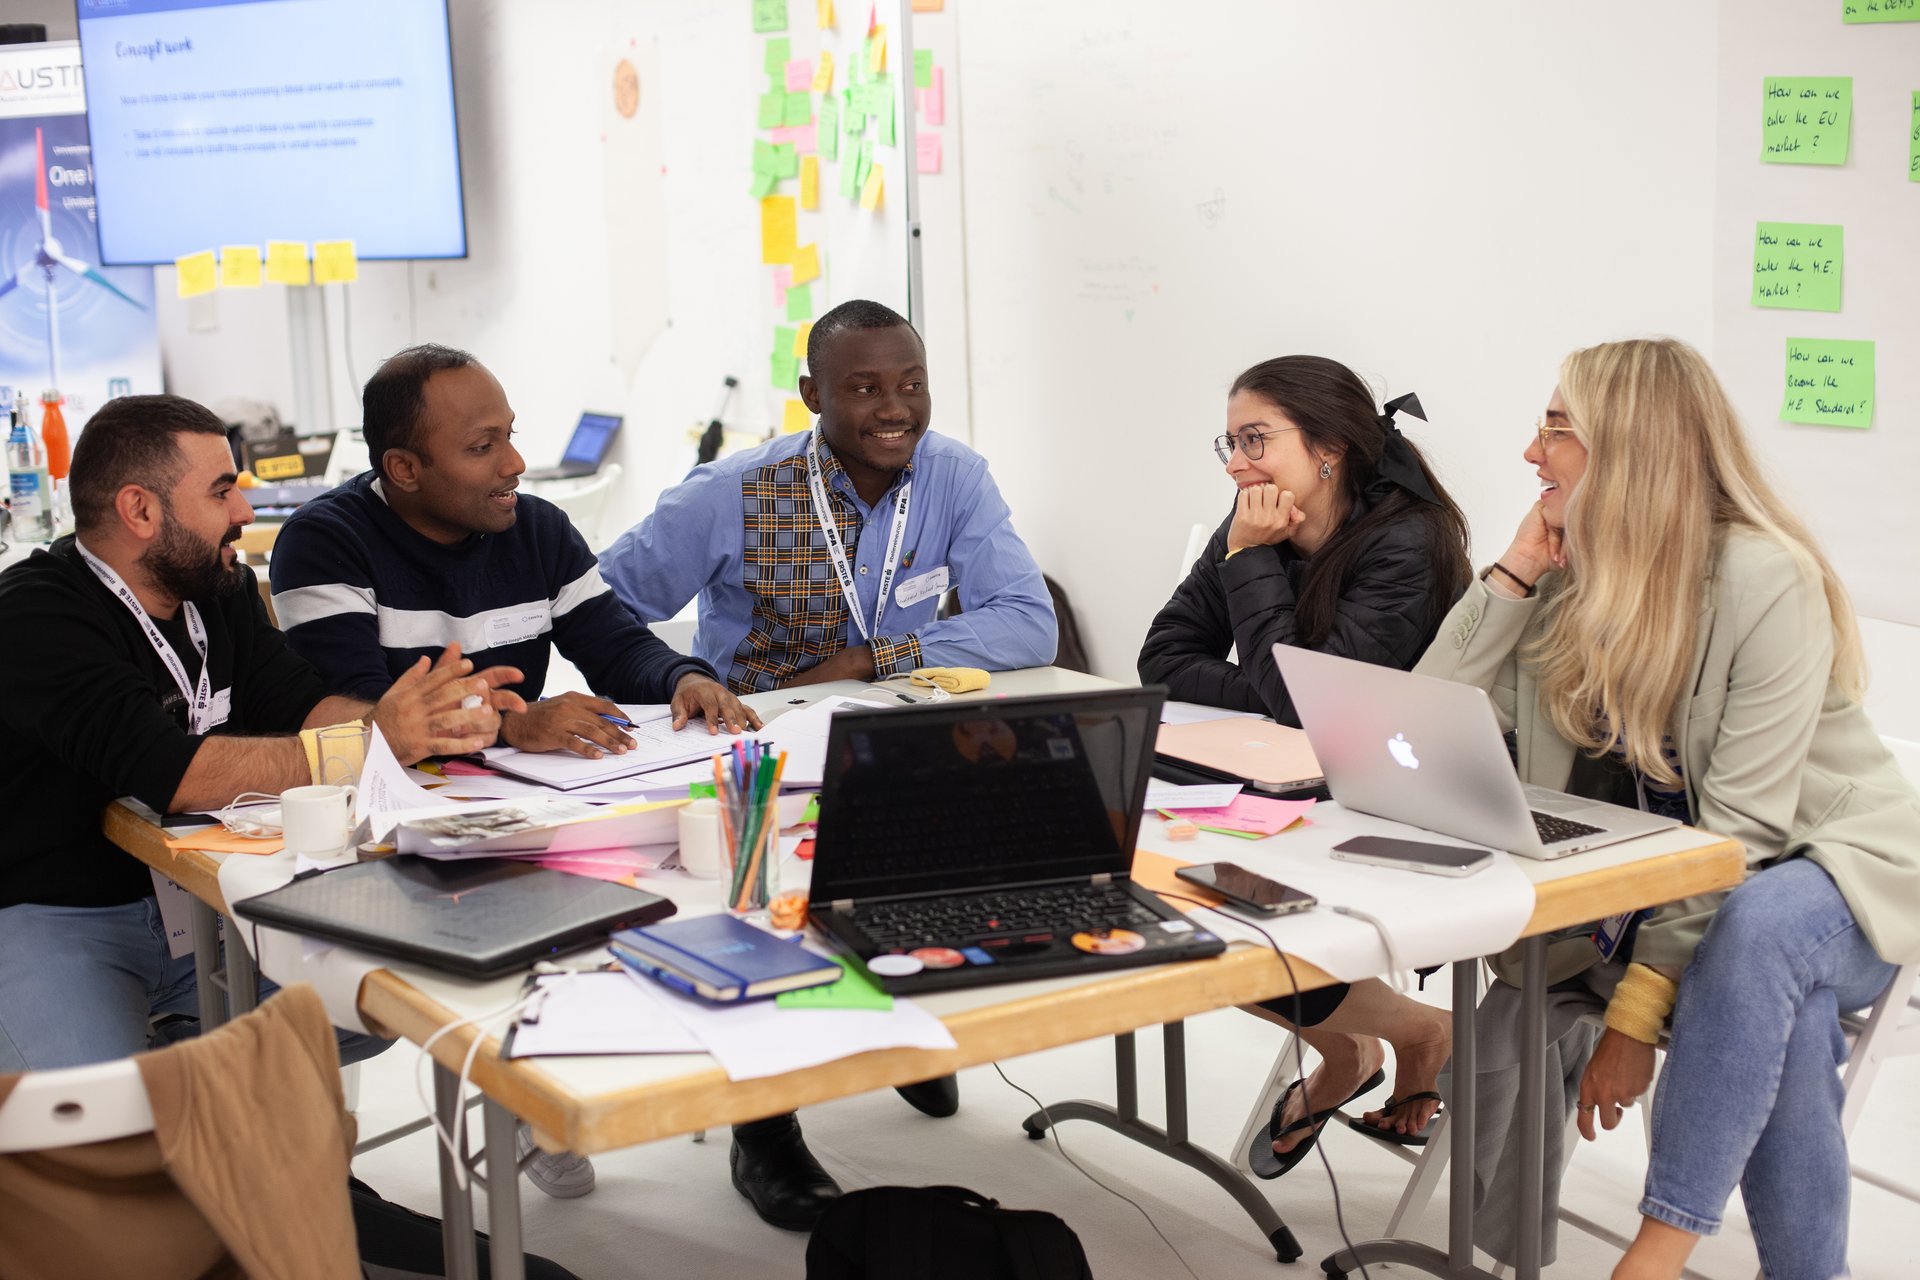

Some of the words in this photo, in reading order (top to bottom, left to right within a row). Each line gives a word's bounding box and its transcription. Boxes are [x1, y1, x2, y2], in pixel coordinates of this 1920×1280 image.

[1768, 82, 1791, 99] How
[1799, 89, 1818, 99] can
[1825, 90, 1840, 100] we
[1766, 109, 1786, 127] enter
[1795, 109, 1808, 125] the
[1818, 110, 1838, 126] EU
[1767, 135, 1801, 153] market
[49, 165, 87, 187] One
[1758, 228, 1778, 246] How
[1786, 236, 1801, 247] can
[1808, 237, 1823, 248] we
[1756, 260, 1779, 273] enter
[1788, 257, 1804, 272] the
[1789, 346, 1810, 362] How
[1817, 354, 1834, 364] can
[1841, 356, 1854, 366] we
[1823, 374, 1839, 388] the
[808, 451, 817, 472] ERSTE
[898, 498, 908, 515] EFA
[826, 528, 838, 546] EFA
[837, 559, 849, 581] ERSTE
[881, 575, 891, 596] ERSTE
[124, 593, 142, 616] ERSTE
[149, 628, 164, 649] EFA
[200, 678, 208, 702] ERSTE
[172, 929, 187, 938] ALL
